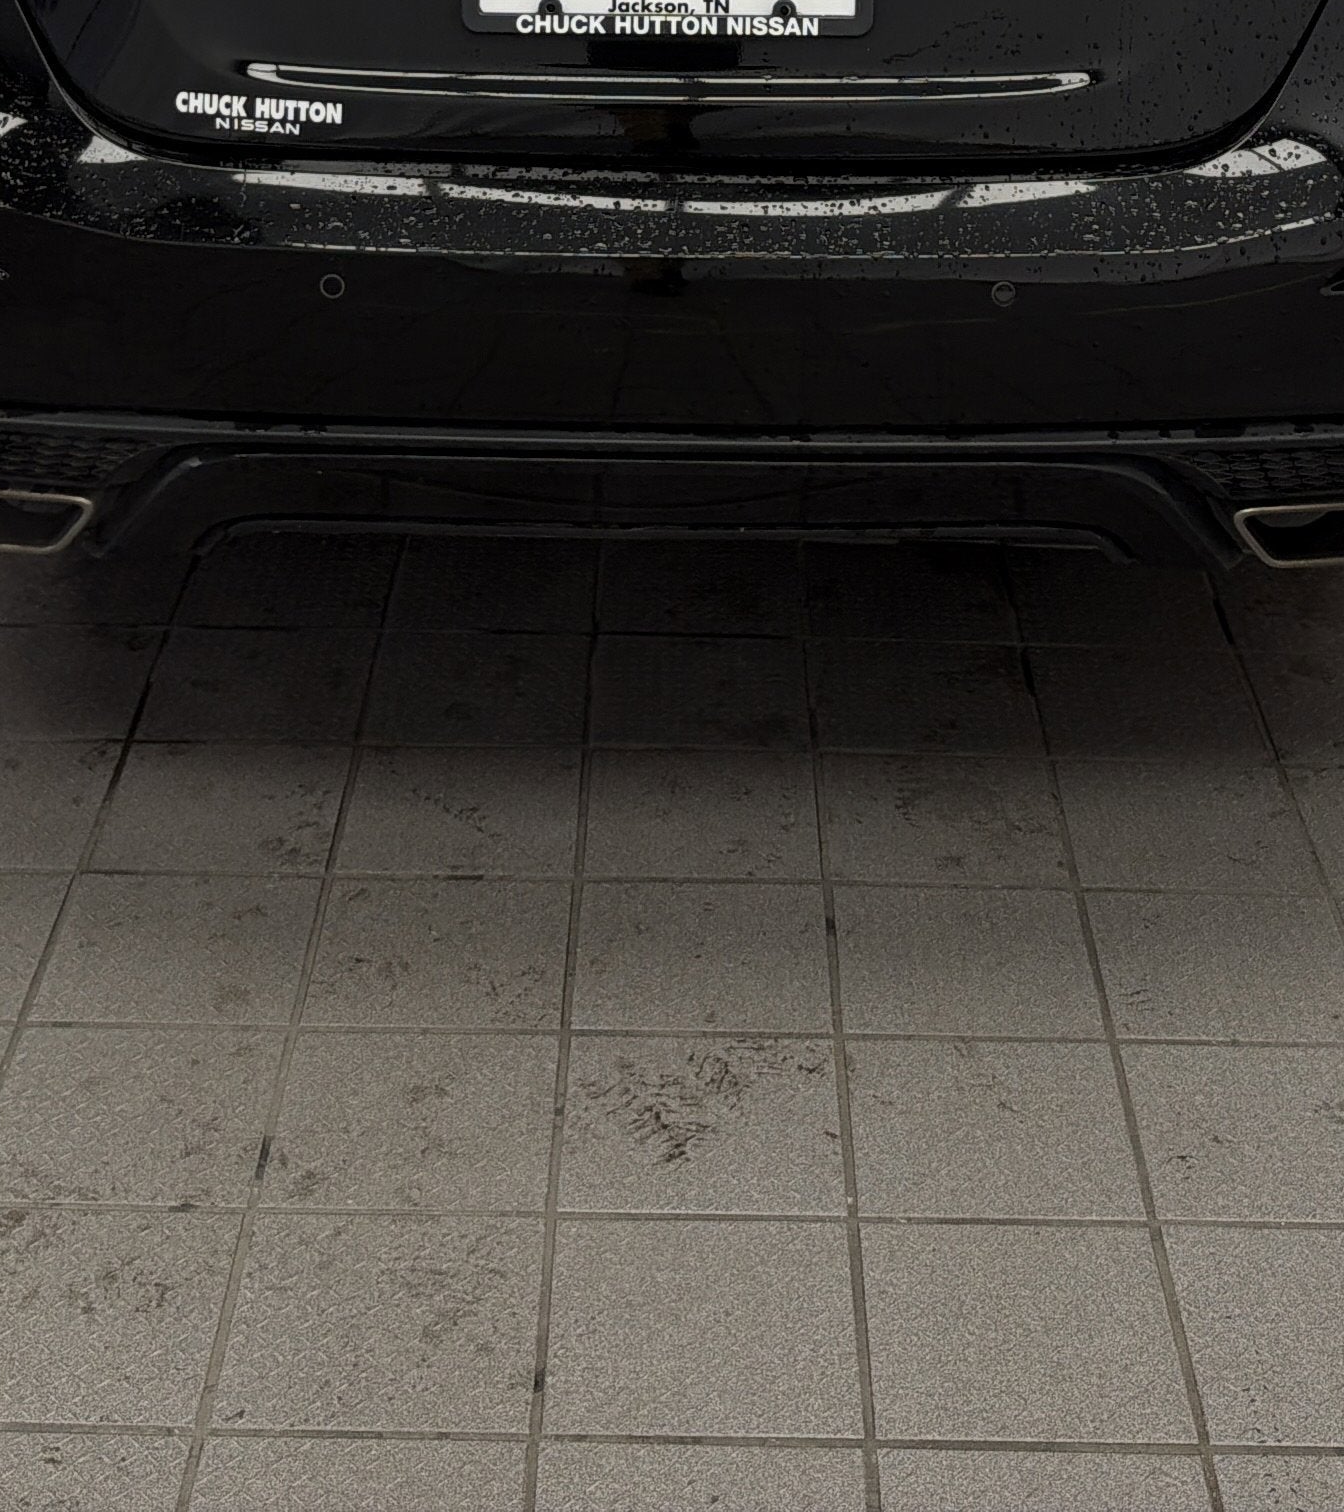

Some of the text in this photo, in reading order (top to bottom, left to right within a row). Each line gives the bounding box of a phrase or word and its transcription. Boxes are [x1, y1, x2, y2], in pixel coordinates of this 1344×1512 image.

[703, 0, 730, 14] TN
[516, 14, 819, 36] CHUCK HUTTON NISSAN
[175, 91, 343, 125] CHUCK HUTTON
[215, 117, 301, 136] NISSAN
